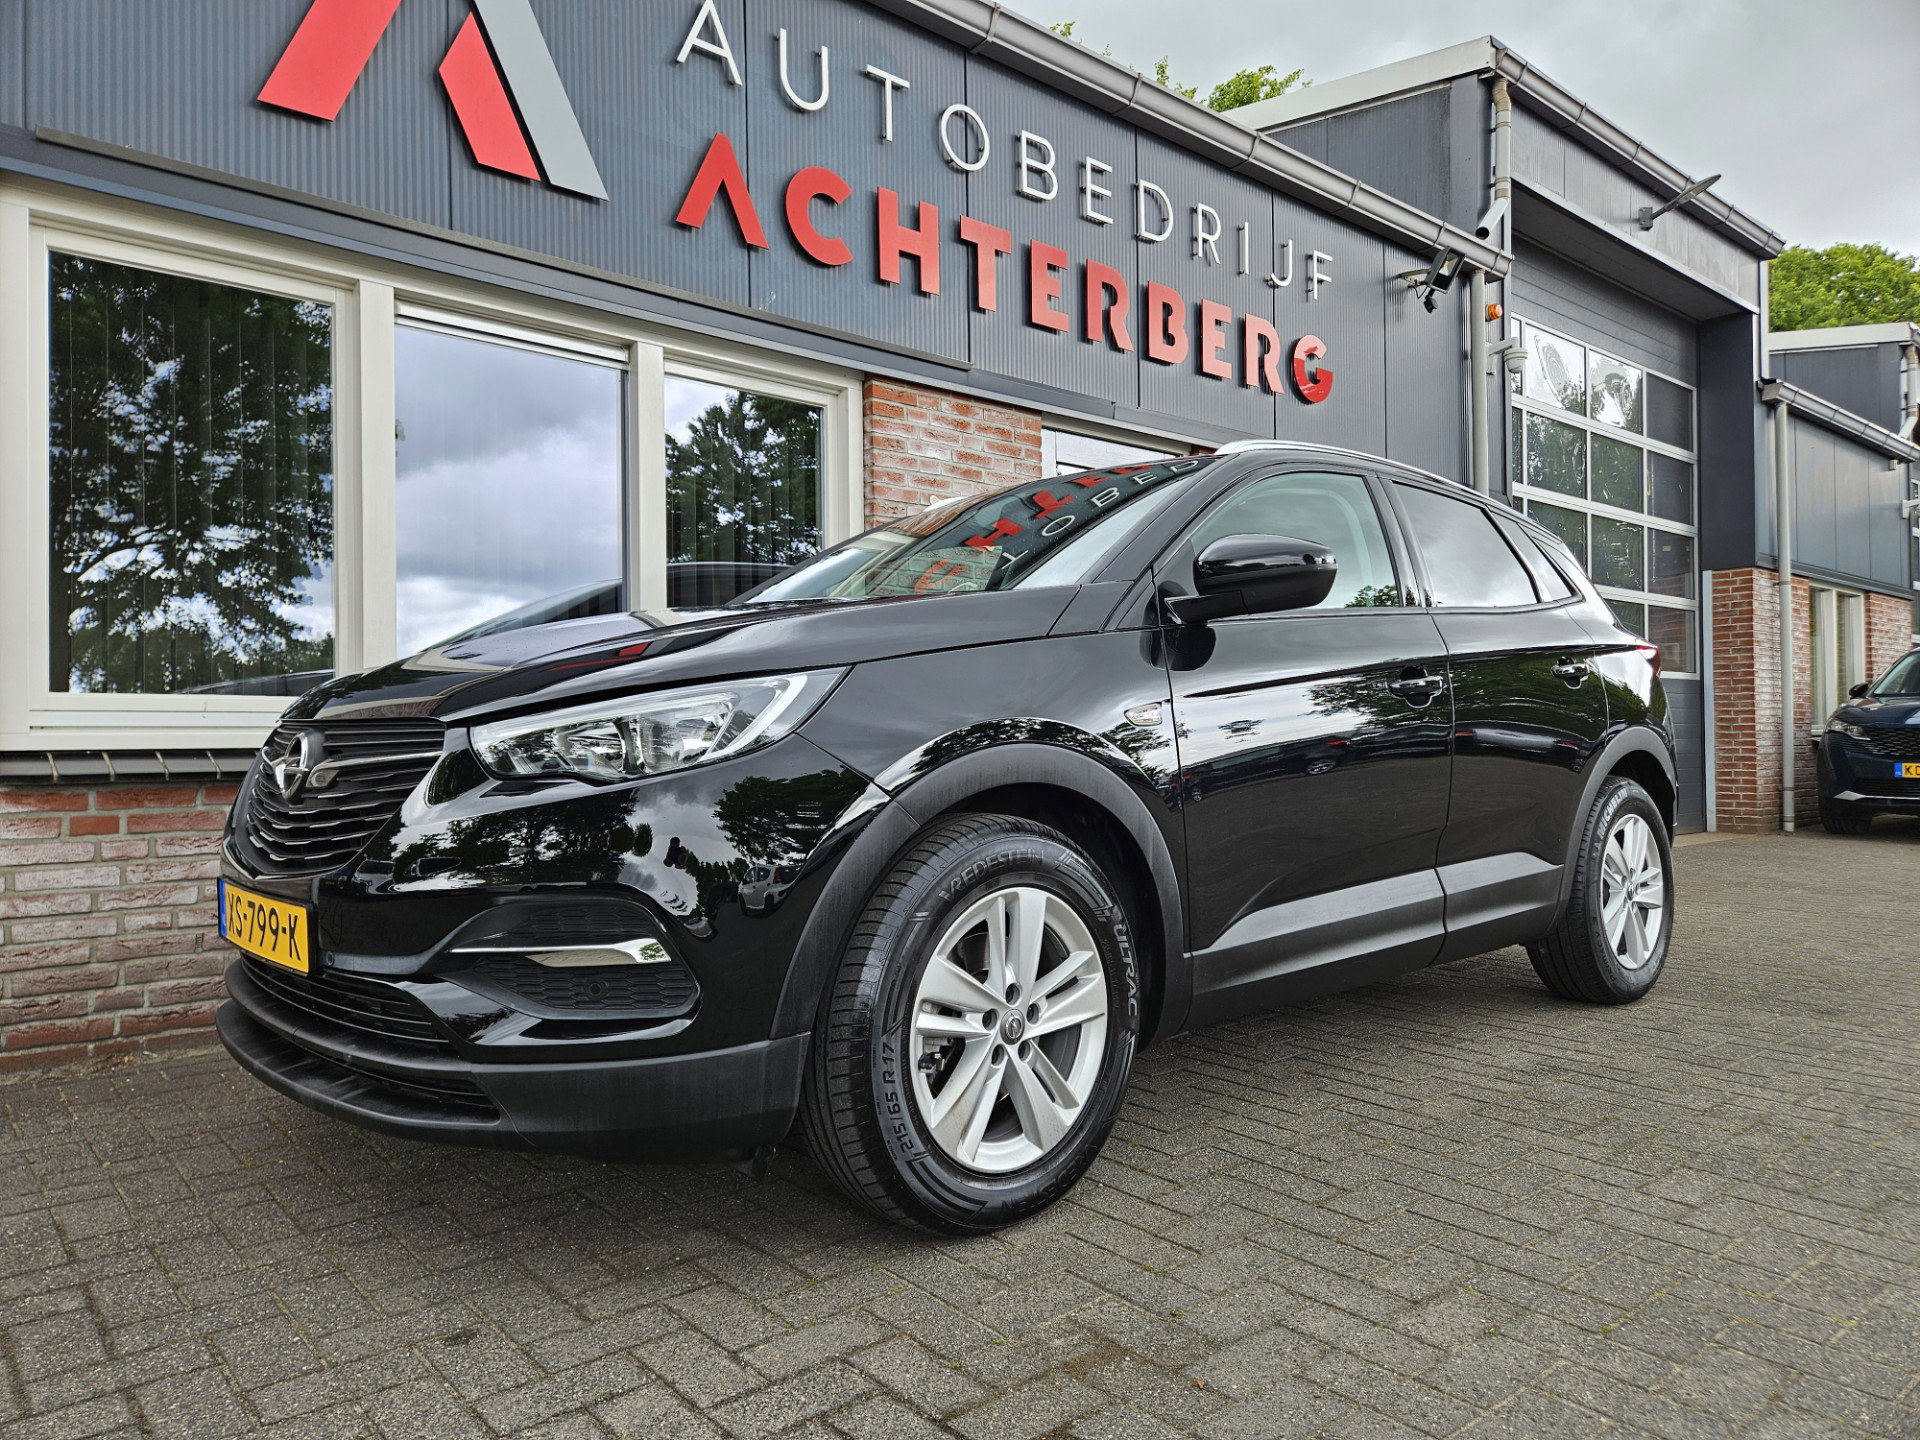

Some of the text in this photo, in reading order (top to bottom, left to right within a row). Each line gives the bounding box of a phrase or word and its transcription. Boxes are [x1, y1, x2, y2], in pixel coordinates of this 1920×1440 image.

[675, 0, 1333, 300] AUTOBEDRIJF
[675, 132, 1334, 404] ACHTERBERG
[227, 891, 302, 961] XS-799-K
[1113, 924, 1138, 1017] ULTRAC
[885, 1091, 914, 1154] 215/65
